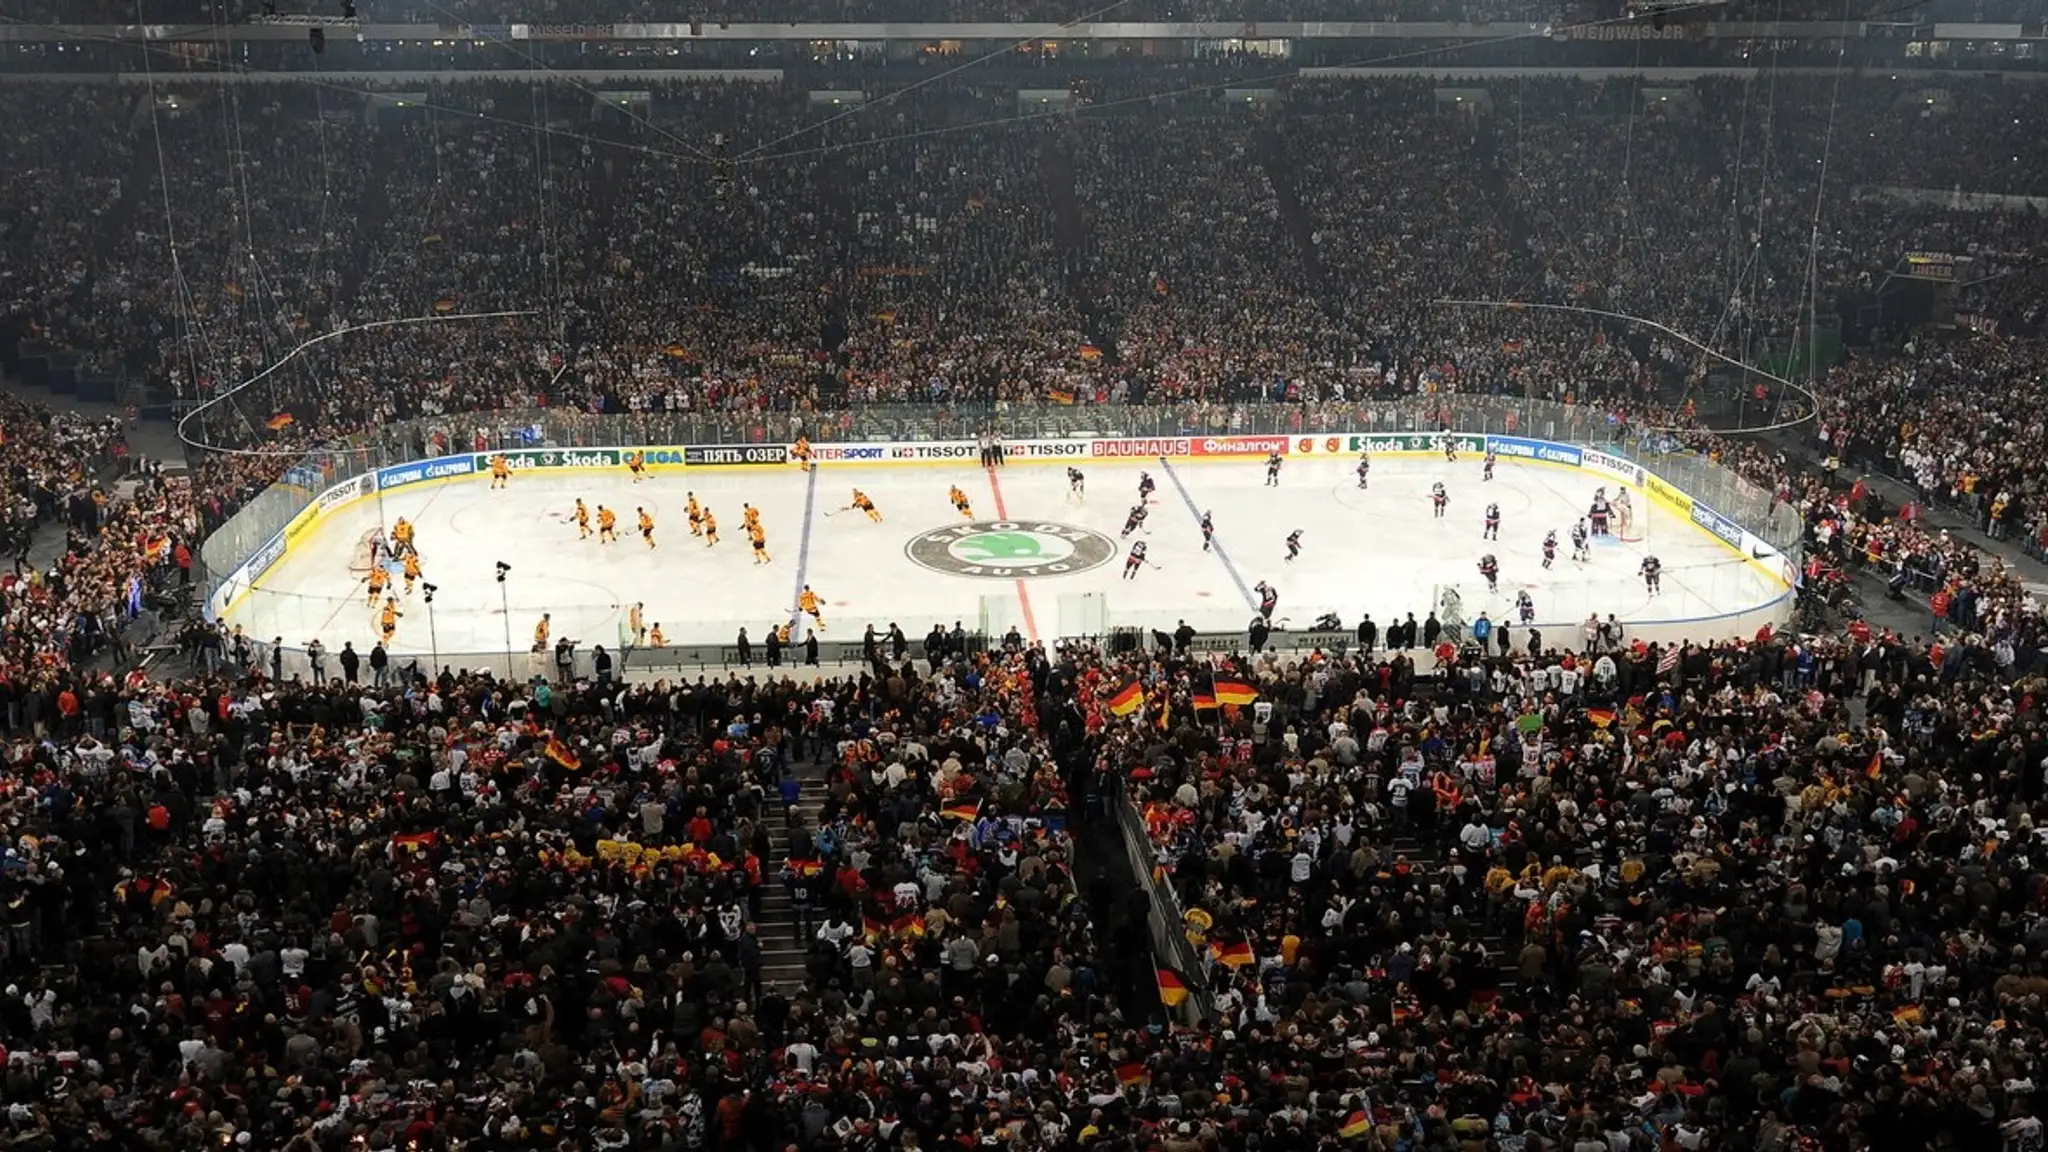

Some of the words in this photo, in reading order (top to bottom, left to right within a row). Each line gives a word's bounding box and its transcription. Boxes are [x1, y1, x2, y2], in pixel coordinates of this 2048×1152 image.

[1028, 444, 1087, 455] TISSOT
[1093, 440, 1188, 456] BAUHAUS
[1357, 437, 1404, 452] Škoda
[562, 448, 612, 466] Škoda
[703, 449, 742, 463] ПЯТЬ
[746, 448, 785, 462] ОЗЕР
[804, 447, 884, 459] NTERSPORT
[916, 446, 976, 458] TISSOT
[1600, 455, 1634, 476] TISSOT
[959, 563, 1071, 575] AUTO
[794, 887, 808, 899] 10
